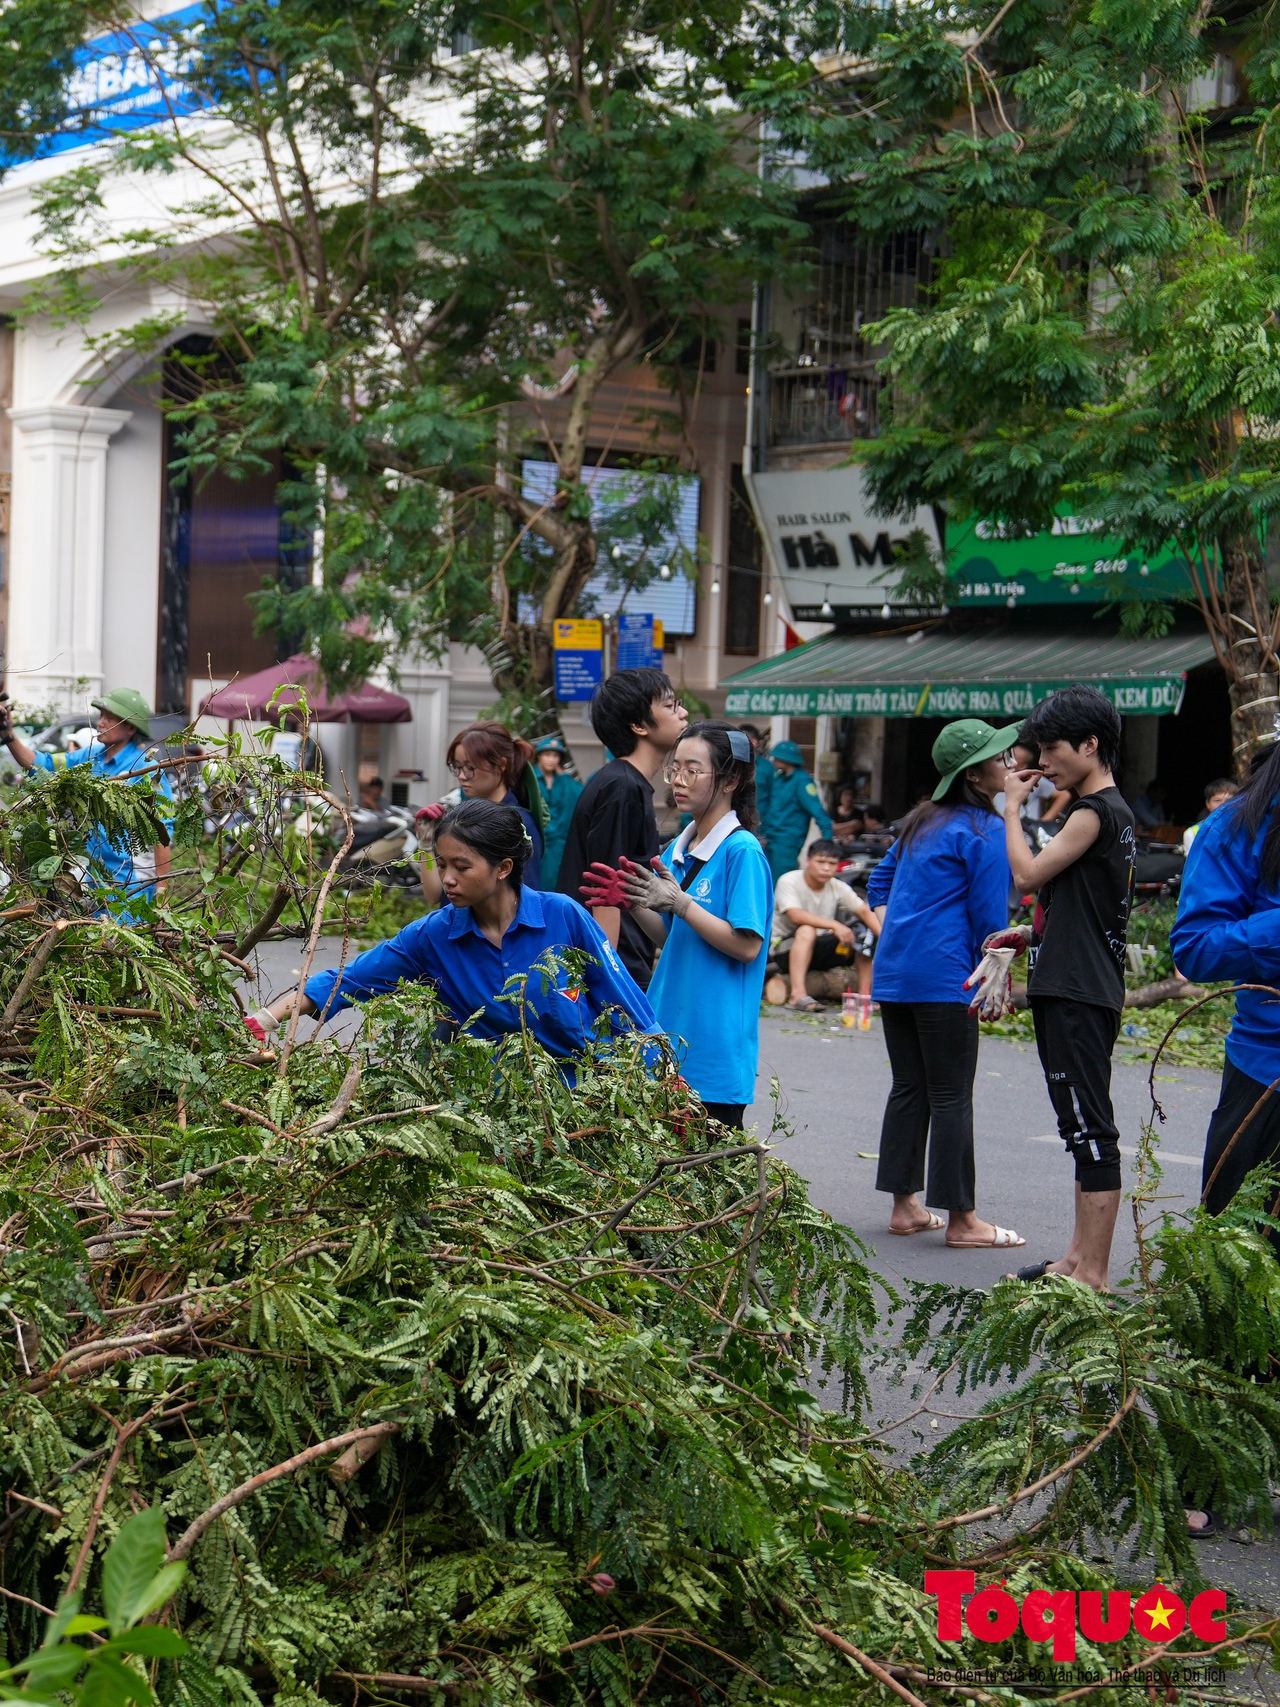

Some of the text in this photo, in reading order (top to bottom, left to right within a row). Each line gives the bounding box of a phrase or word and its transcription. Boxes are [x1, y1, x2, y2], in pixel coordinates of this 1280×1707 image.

[776, 511, 852, 527] HAIR SALON
[1093, 559, 1128, 574] 2010
[993, 580, 1026, 600] Triệu
[726, 689, 750, 712] CHÈ
[750, 689, 777, 712] CÁC
[778, 692, 809, 716] LOẠI
[818, 688, 853, 712] BÁNH
[854, 688, 888, 712] TRÔI
[889, 689, 920, 712] TÀU
[927, 686, 967, 711] NƯỚC
[968, 691, 1001, 711] HOA
[1003, 684, 1035, 714] QUẢ
[1114, 687, 1148, 708] KEM
